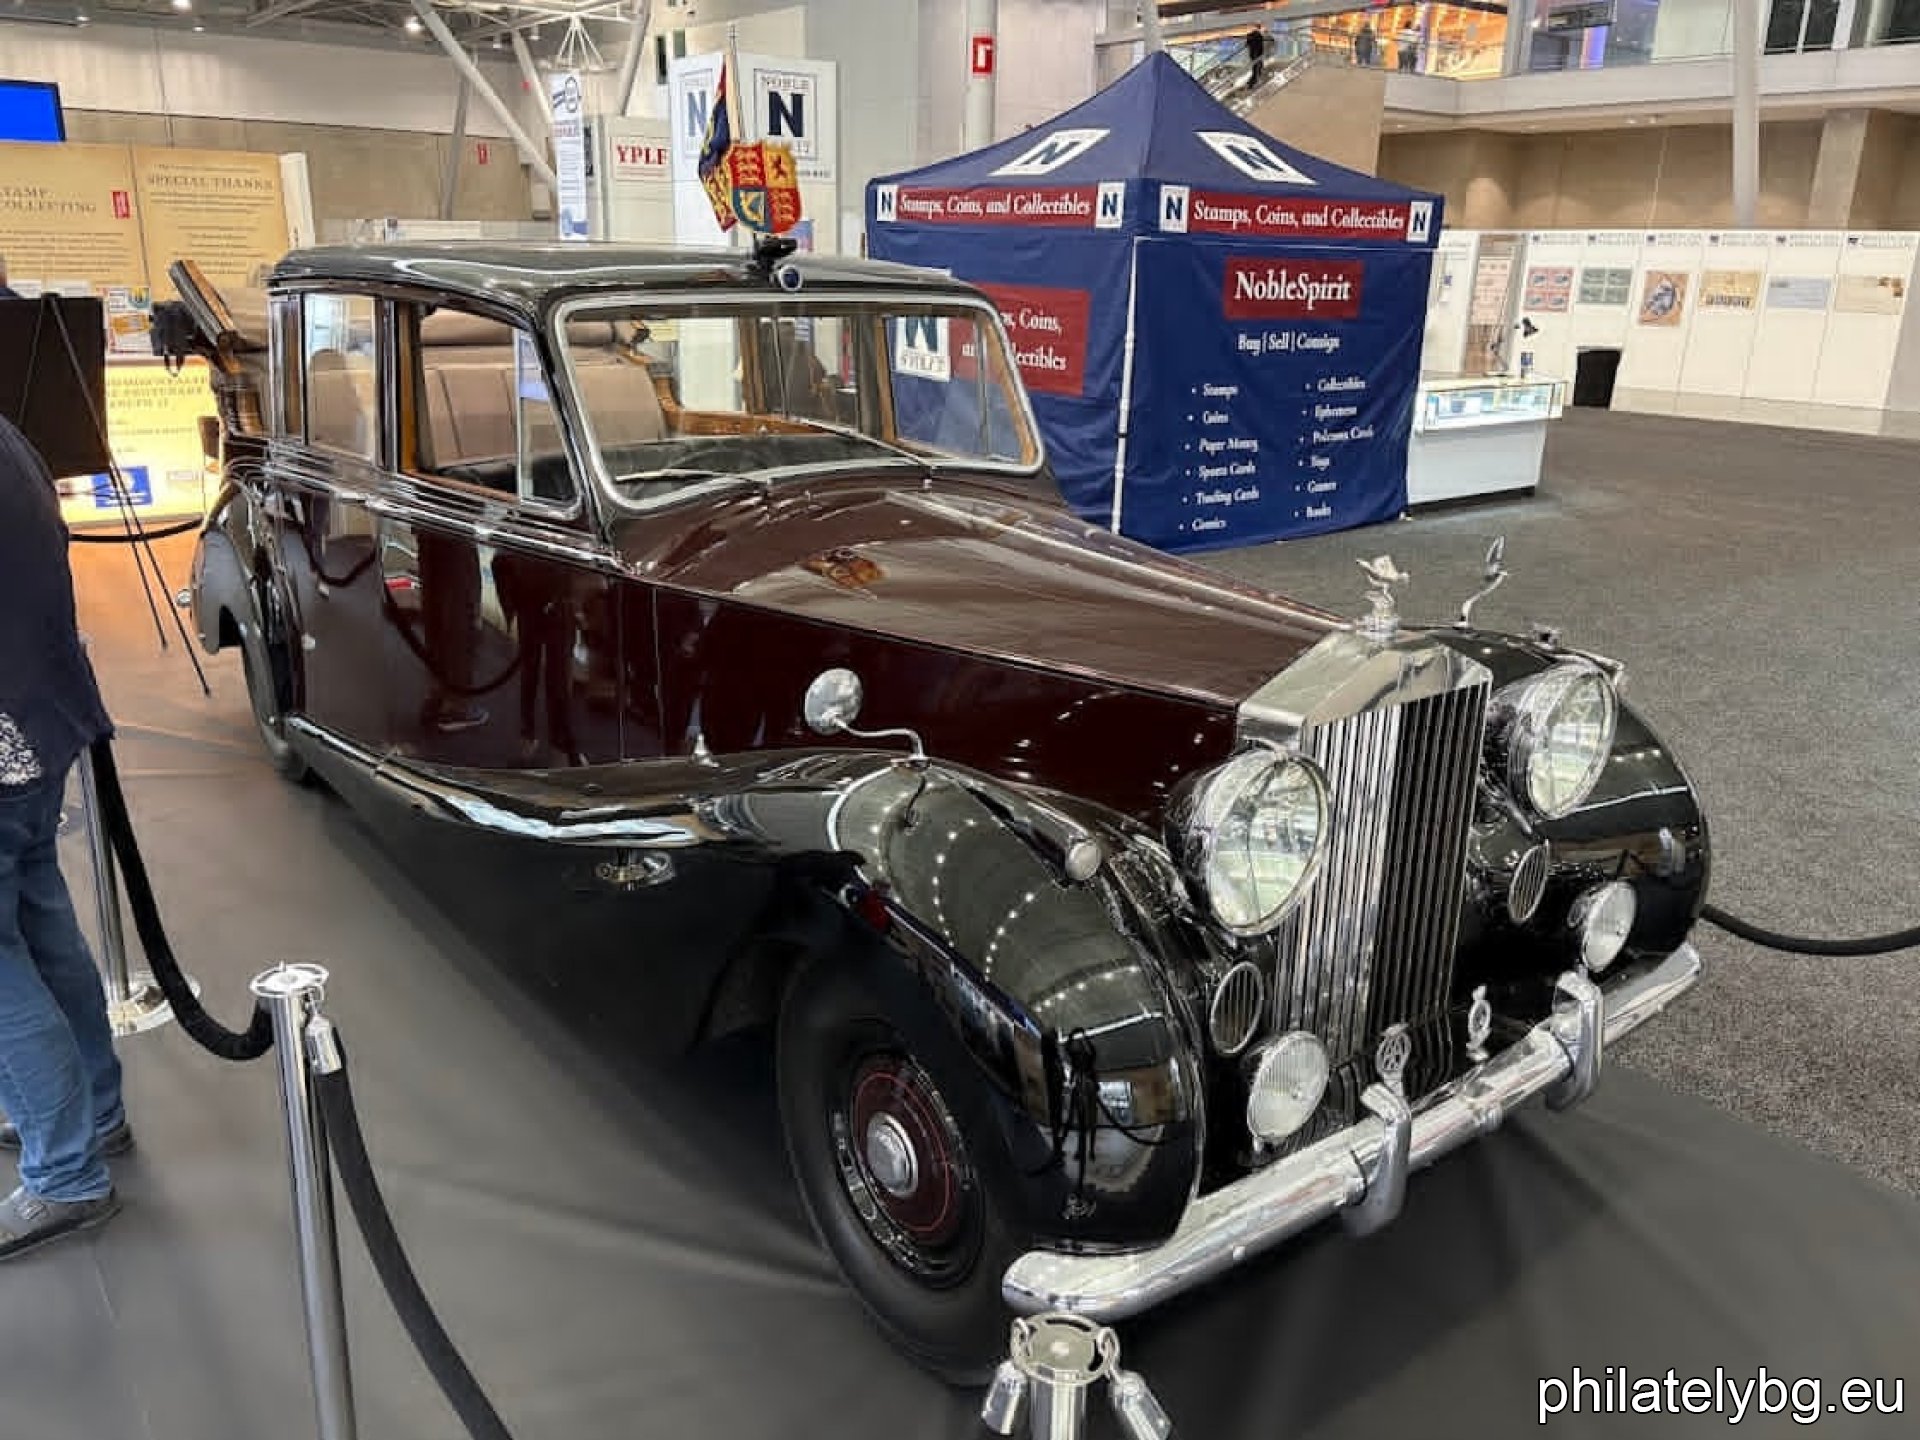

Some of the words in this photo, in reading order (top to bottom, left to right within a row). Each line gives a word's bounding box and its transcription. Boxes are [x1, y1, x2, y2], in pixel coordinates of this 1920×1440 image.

[767, 91, 805, 138] N
[900, 194, 945, 219] Stamps,
[947, 193, 983, 216] Coins,
[986, 193, 1011, 214] and
[1013, 191, 1091, 215] Collectibles
[1194, 200, 1251, 229] Stamps,
[1255, 204, 1299, 228] Coins,
[1302, 205, 1328, 228] and
[1330, 208, 1405, 229] Collectibles
[1234, 268, 1351, 310] NobleSpirit
[1019, 307, 1063, 335] Coins,
[1237, 333, 1261, 356] Buy
[1268, 332, 1289, 351] Sell
